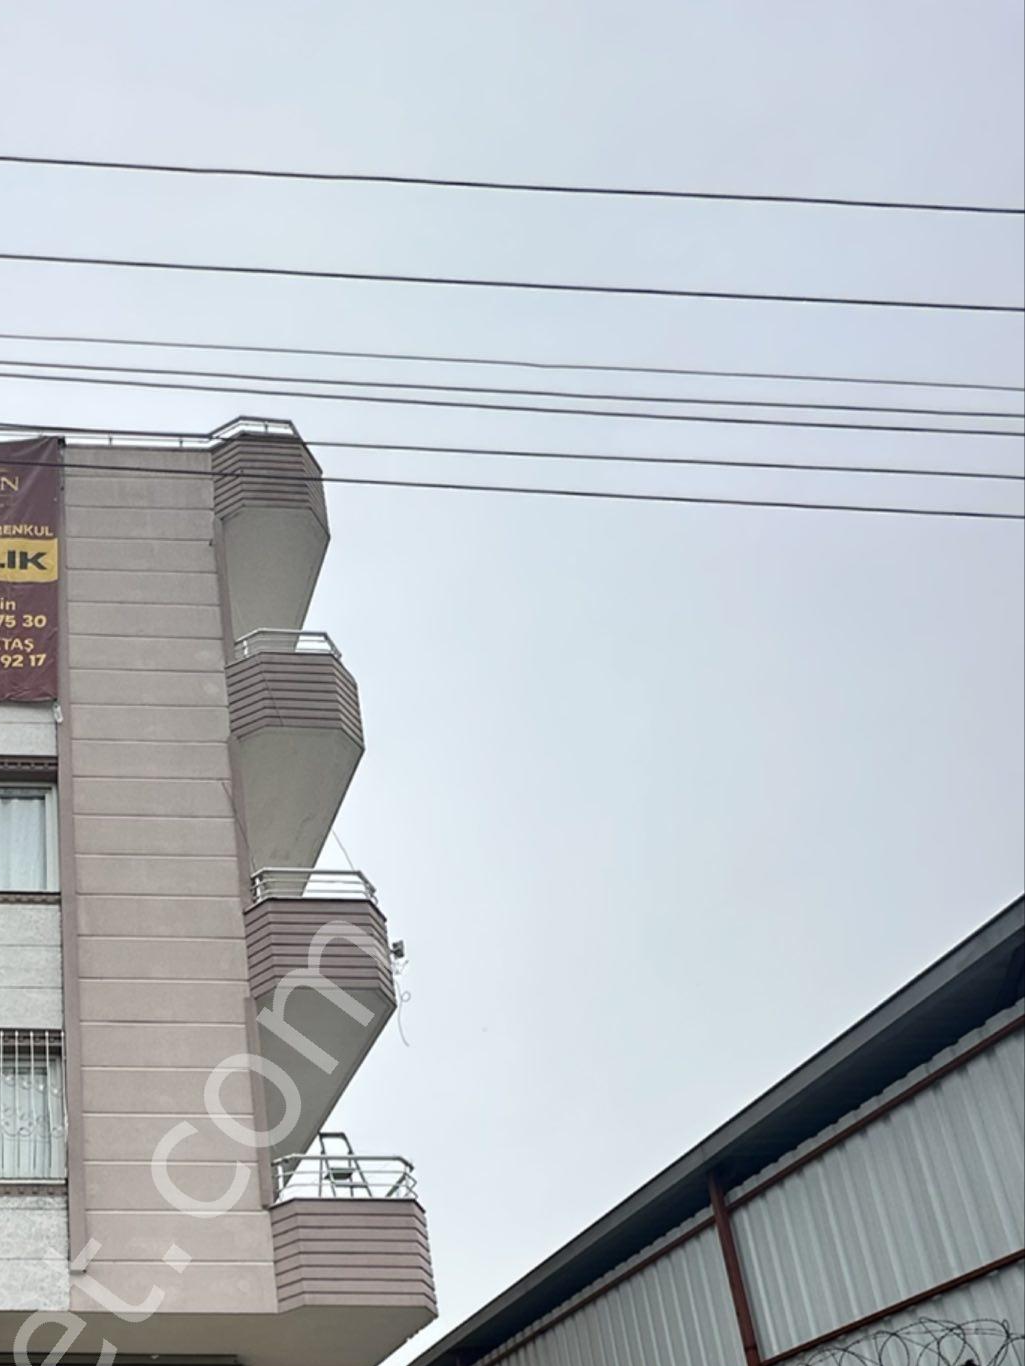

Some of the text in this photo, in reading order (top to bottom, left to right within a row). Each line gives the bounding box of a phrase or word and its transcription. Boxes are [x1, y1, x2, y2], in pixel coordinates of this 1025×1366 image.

[22, 614, 47, 628] 30
[0, 654, 24, 668] 92
[29, 653, 47, 667] 17
